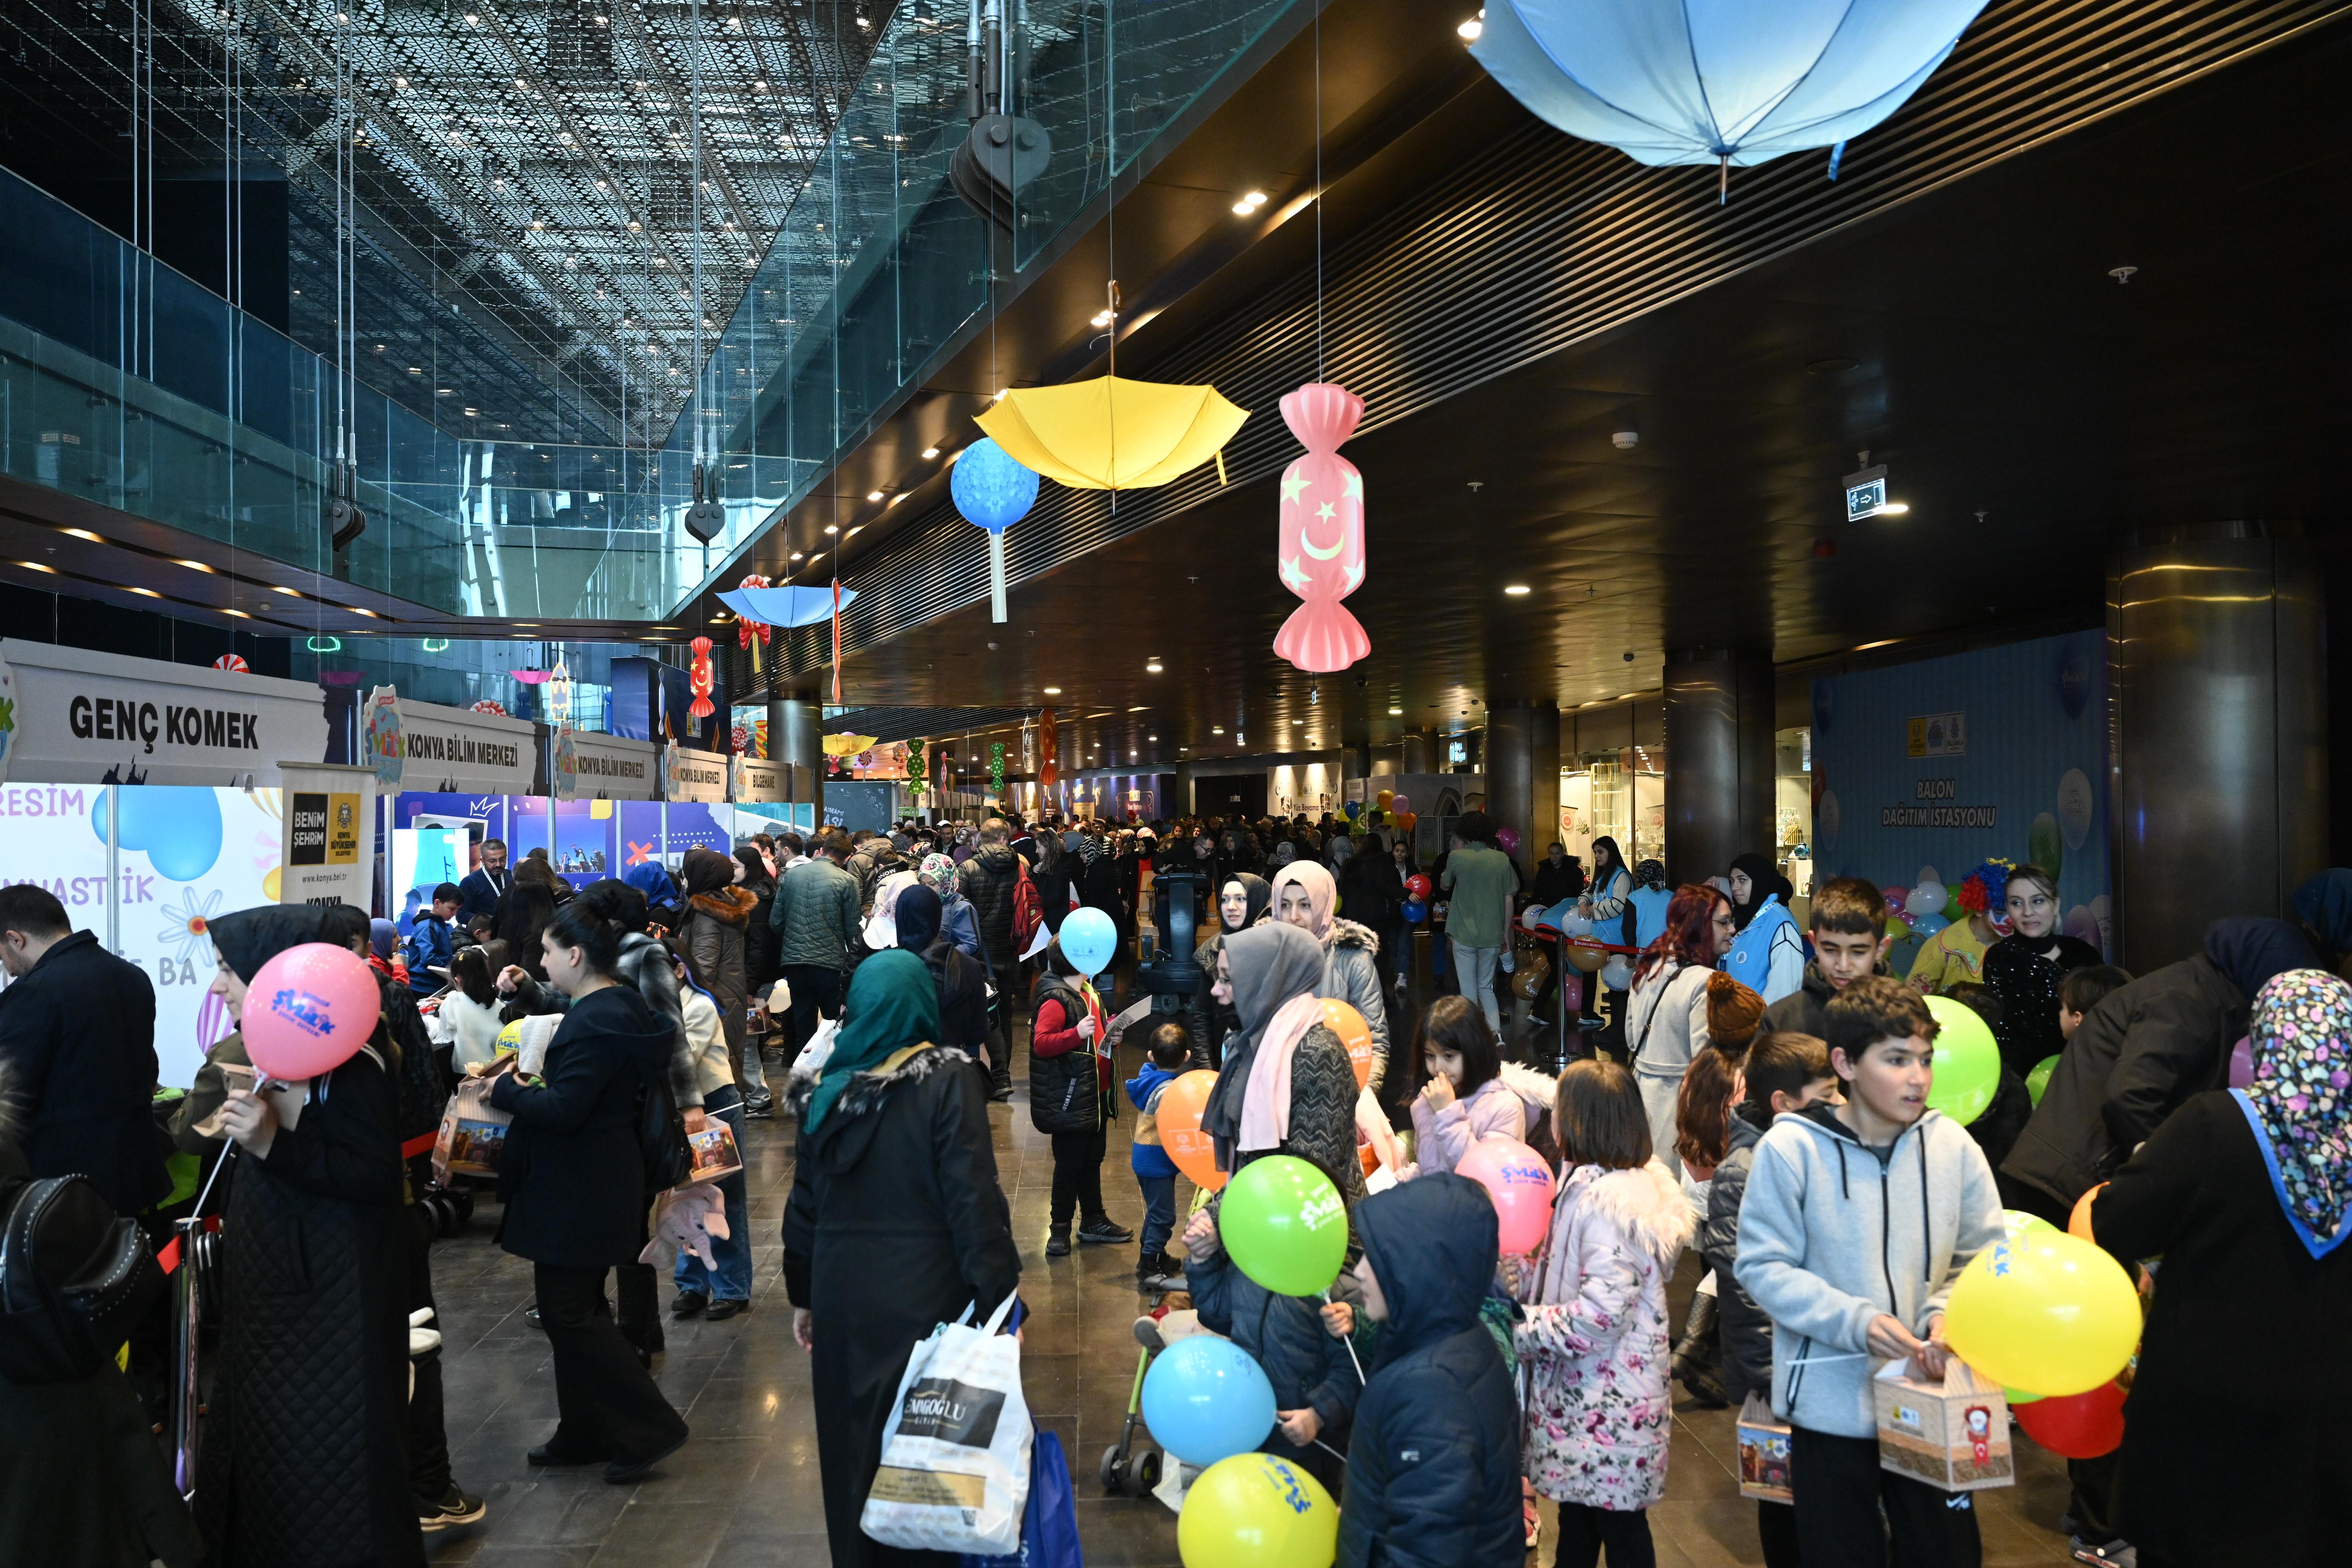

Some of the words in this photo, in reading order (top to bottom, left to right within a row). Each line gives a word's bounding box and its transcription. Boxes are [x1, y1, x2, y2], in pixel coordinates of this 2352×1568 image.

[70, 695, 158, 754] GENÇ
[166, 705, 259, 749] KOMEK
[407, 733, 444, 760] KONYA
[447, 733, 475, 763] BİLİM
[477, 742, 518, 767] MERKEZİ
[578, 756, 599, 775] KONYA
[601, 756, 618, 777] BİLİM
[619, 761, 645, 778] MERKEZİ
[680, 767, 693, 782] KONYA
[694, 766, 704, 784] BİLİM
[705, 770, 720, 784] MERKEZİ
[753, 771, 775, 789] BİLGEHANE
[1917, 779, 1955, 799] BALON
[824, 806, 844, 817] AYRAMI
[1302, 804, 1319, 813] Boyama
[1883, 802, 1927, 827] DAĞITIM
[1930, 803, 1996, 827] İSTASYONU
[302, 872, 346, 883] www.konya.bel.tr
